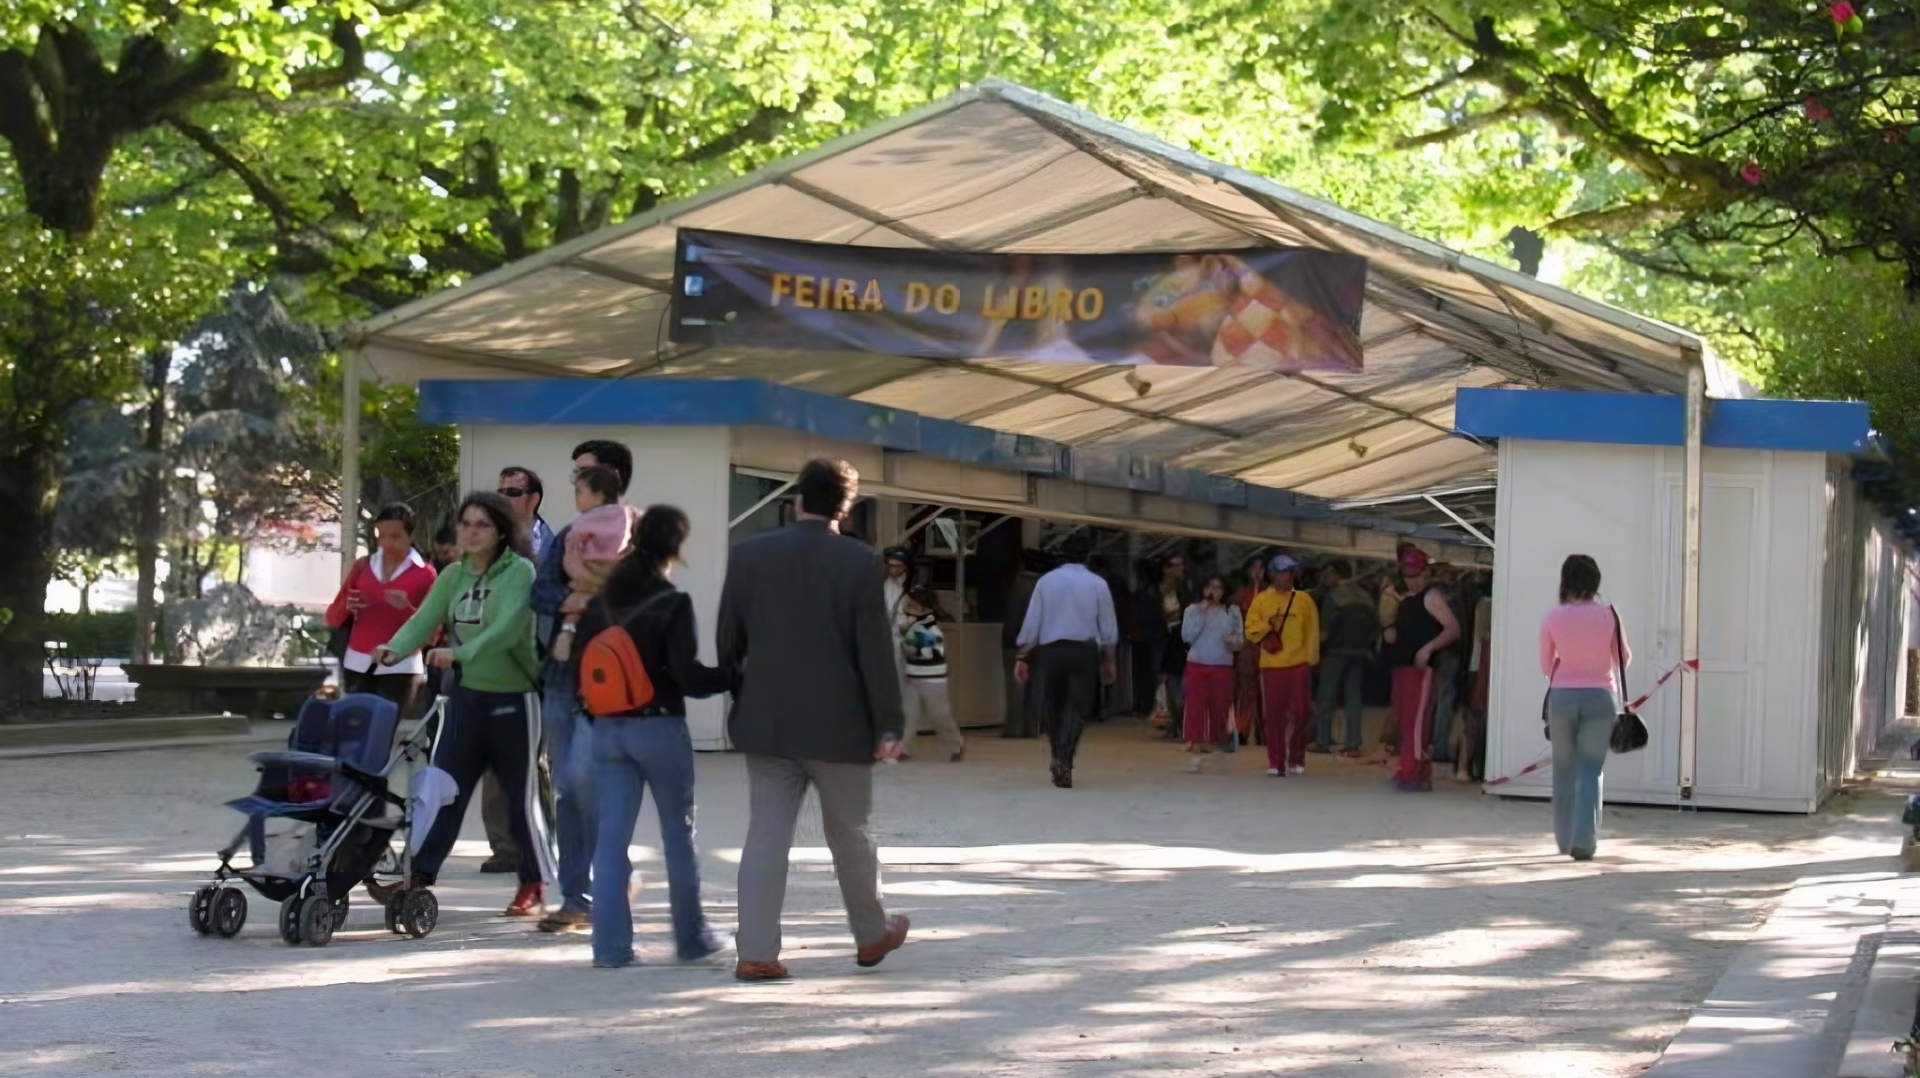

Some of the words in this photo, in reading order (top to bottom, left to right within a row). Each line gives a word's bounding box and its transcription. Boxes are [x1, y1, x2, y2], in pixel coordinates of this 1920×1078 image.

[771, 273, 883, 312] FEIRA
[905, 282, 961, 315] DO
[982, 284, 1105, 322] LIBRO
